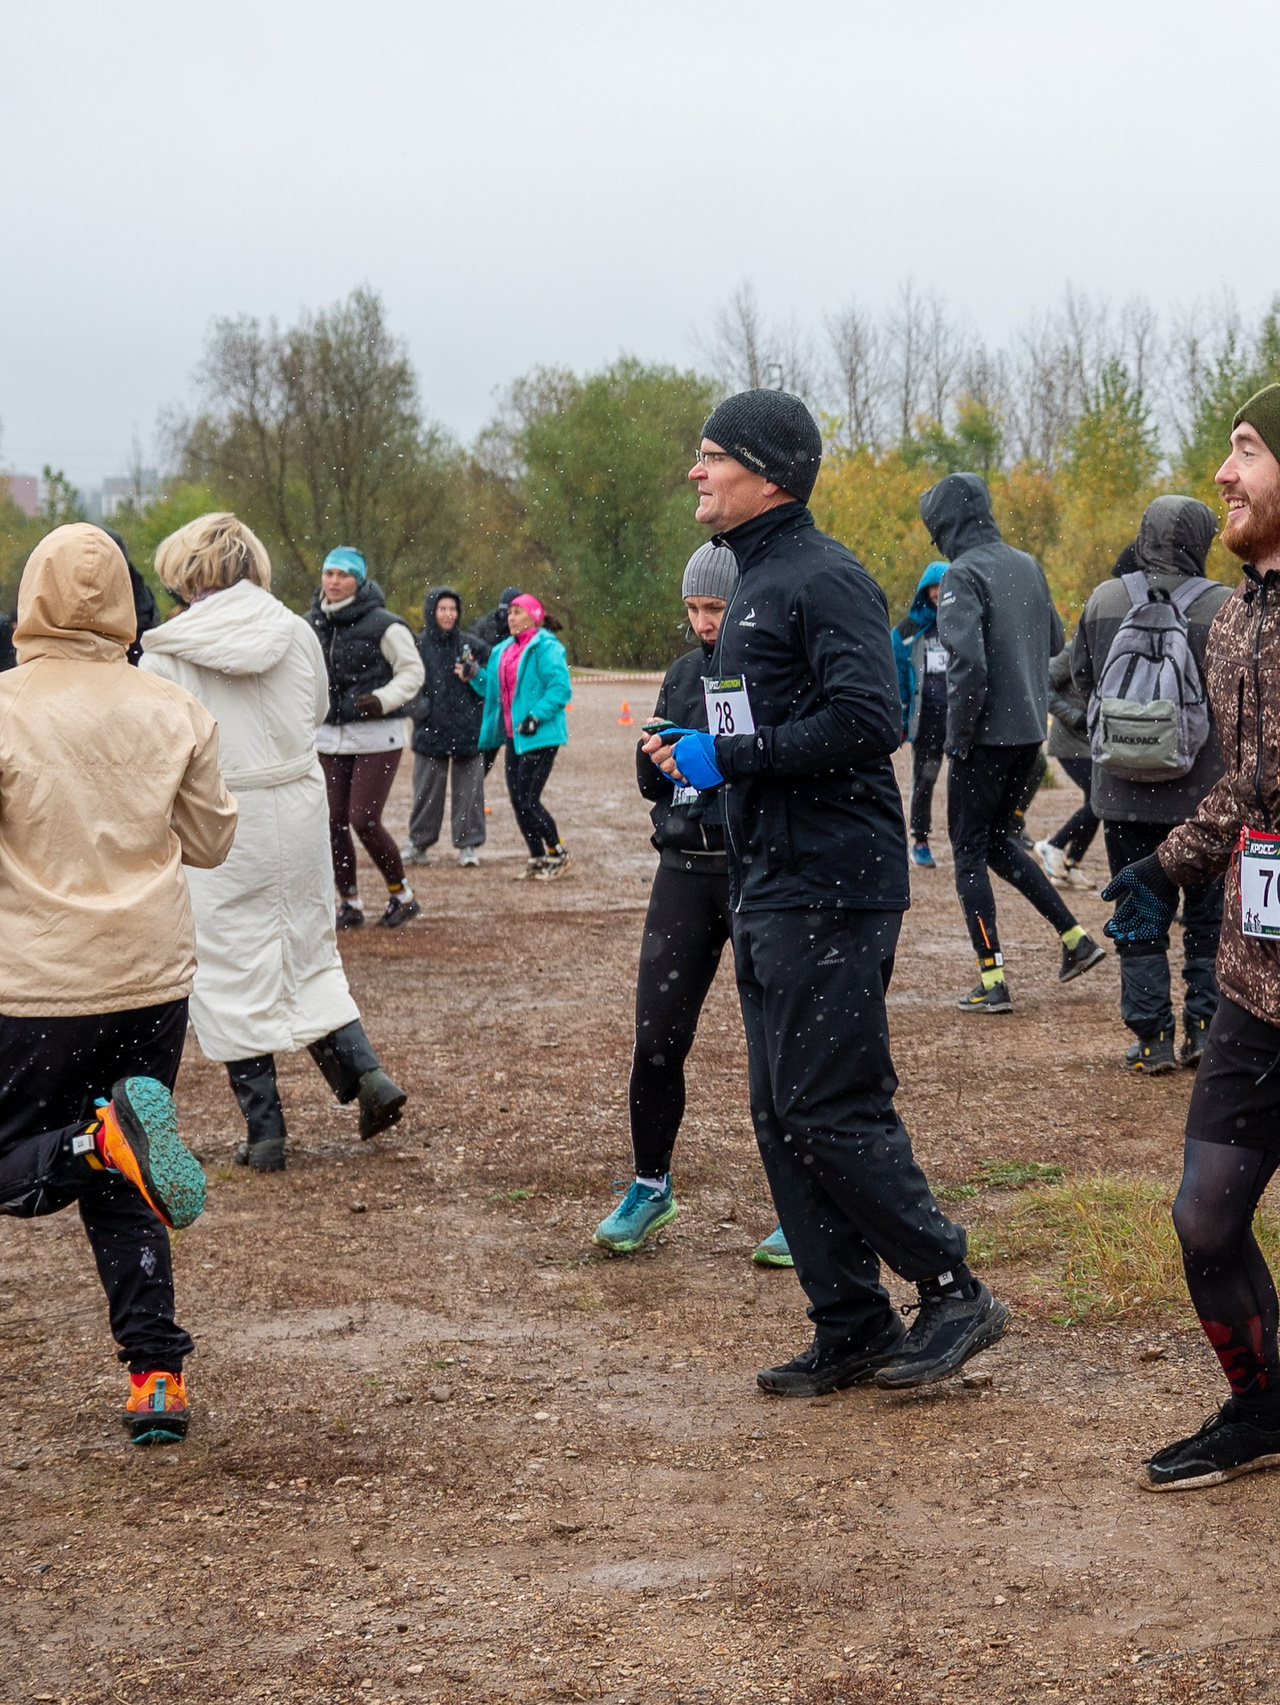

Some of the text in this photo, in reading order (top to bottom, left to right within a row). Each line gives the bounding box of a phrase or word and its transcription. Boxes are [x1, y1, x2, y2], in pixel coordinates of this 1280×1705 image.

[715, 700, 735, 734] 28
[1112, 734, 1161, 745] BACKPACK
[1250, 843, 1278, 855] КРОСС
